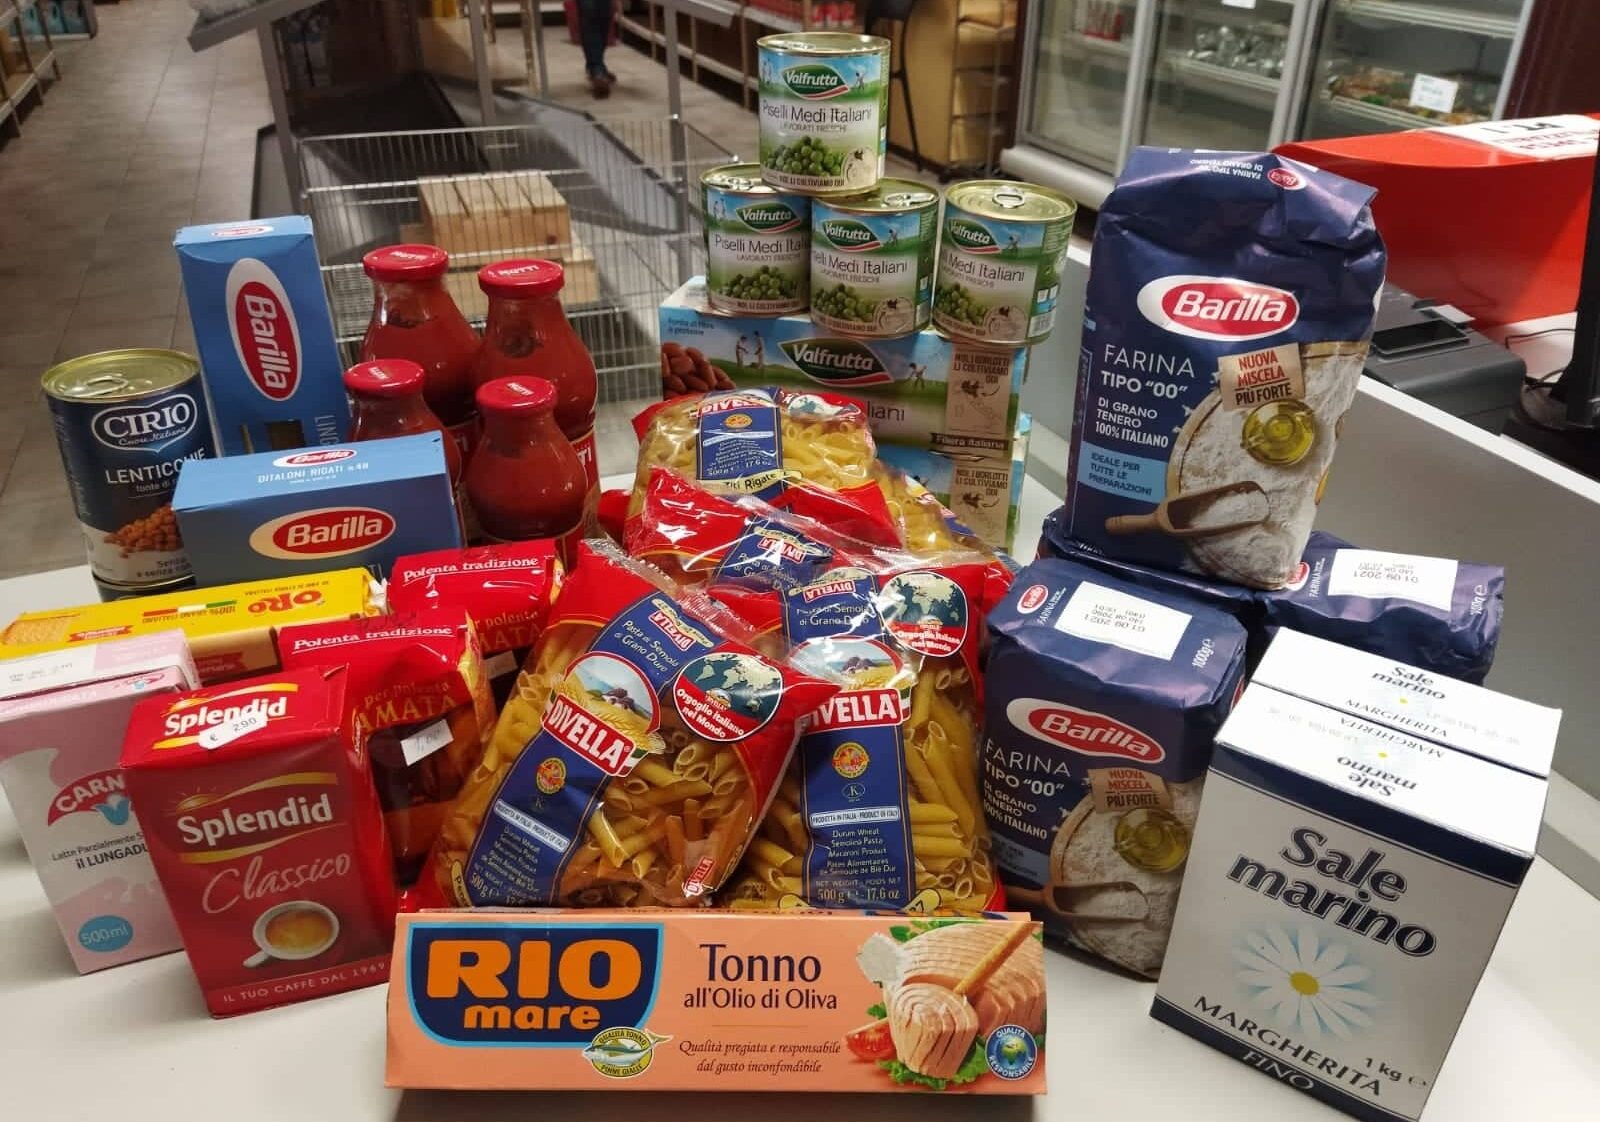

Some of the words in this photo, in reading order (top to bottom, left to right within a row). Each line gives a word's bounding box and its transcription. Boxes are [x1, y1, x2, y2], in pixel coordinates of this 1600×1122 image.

[785, 69, 839, 86] Valfrutta
[791, 106, 826, 122] Medi
[830, 104, 872, 122] Italiani
[742, 207, 792, 221] Valfrutta
[715, 233, 745, 251] Piselli
[750, 239, 783, 254] Medi
[824, 223, 871, 241] Valfrutta
[829, 256, 859, 274] Medi
[863, 260, 908, 275] Italiani
[950, 255, 976, 274] Medi
[979, 263, 1025, 282] Italiani
[1173, 289, 1287, 323] Barilla
[244, 293, 291, 389] Barilla
[791, 341, 875, 370] Valfrutta
[1104, 344, 1195, 378] FARINA
[1238, 350, 1279, 369] NUOVA
[1100, 370, 1142, 393] TIPO
[1237, 365, 1285, 387] MISCELA
[1256, 383, 1293, 402] FORTE
[103, 402, 191, 438] CIRIO
[866, 400, 907, 423] liani
[1096, 408, 1142, 429] TENERO
[1098, 397, 1111, 409] DI
[1112, 401, 1158, 420] GRANO
[150, 426, 187, 442] Italiano
[1095, 421, 1120, 439] 100%
[1121, 429, 1169, 449] ITALIANO
[1090, 452, 1121, 468] IDEALE
[1122, 458, 1140, 471] PER
[1090, 463, 1115, 477] TUTTE
[1116, 469, 1128, 480] LE
[257, 471, 307, 484] DITALONI
[310, 466, 344, 481] RIGATI
[1088, 472, 1152, 496] PREPARAZIONI
[286, 514, 383, 548] Barilla
[403, 562, 457, 583] Polenta
[462, 557, 539, 572] tradizione
[248, 589, 322, 613] ORO
[803, 580, 857, 602] DIVELLA
[650, 610, 696, 651] DIVELLA
[810, 616, 845, 626] Grano
[293, 632, 360, 650] Polenta
[365, 625, 453, 640] tradizione
[622, 619, 644, 642] Pasta
[650, 640, 681, 668] Semola
[622, 635, 648, 657] Grano
[646, 651, 668, 673] Duro
[1371, 672, 1446, 701] marino
[1391, 666, 1434, 687] Sale
[163, 696, 289, 737] Splendid
[676, 688, 712, 715] Orgoglio
[710, 709, 745, 736] italiano
[682, 706, 698, 720] nel
[696, 715, 727, 739] Mondo
[1345, 698, 1449, 738] MARGHERITA
[550, 701, 632, 769] DIVELLA
[1041, 713, 1151, 757] Barilla
[1340, 717, 1445, 758] MARGHERITA
[986, 738, 1071, 777] FARINA
[984, 759, 1019, 788] TIPO
[1108, 779, 1152, 791] MISCELA
[1110, 769, 1145, 780] NUOVA
[1336, 755, 1418, 792] marino
[1348, 772, 1395, 798] Sale
[56, 773, 126, 812] CARN
[983, 792, 1023, 817] TENERO
[984, 781, 994, 793] DI
[995, 788, 1037, 813] GRANO
[1127, 794, 1160, 806] FORTE
[177, 793, 334, 847] Splendid
[857, 828, 880, 837] Wheat
[1003, 811, 1048, 840] ITALIANO
[52, 850, 76, 862] Latte
[76, 835, 137, 856] Parzialmente
[828, 848, 860, 857] Macaroni
[861, 847, 887, 856] Product
[831, 838, 862, 847] Semolina
[863, 837, 883, 846] Pasta
[687, 858, 713, 893] DIVELLA
[847, 858, 889, 867] Alimentaires
[1280, 827, 1407, 903] Sale
[201, 852, 351, 915] Classico
[1226, 854, 1437, 958] marino
[80, 924, 128, 945] 500ml
[426, 938, 642, 1001] RIO
[699, 943, 822, 984] Tonno
[222, 993, 235, 1003] IL
[240, 987, 269, 1001] TUO
[273, 978, 315, 995] CAFFÈ
[320, 971, 348, 985] DAL
[683, 987, 756, 1010] all'Olio
[761, 988, 780, 1009] di
[785, 987, 838, 1010] Oliva
[463, 1003, 601, 1031] mare
[679, 1040, 723, 1056] Qualità
[724, 1041, 768, 1056] pregiata
[769, 1044, 776, 1053] e
[778, 1041, 842, 1056] responsabile
[1194, 995, 1382, 1097] MARGHERITA
[697, 1060, 715, 1073] dal
[715, 1061, 746, 1075] gusto
[747, 1060, 822, 1075] inconfondibile
[989, 1055, 1035, 1078] RESPONSABILE
[1242, 1050, 1315, 1092] FINO
[1364, 1057, 1374, 1068] 1
[1379, 1063, 1403, 1083] kg
